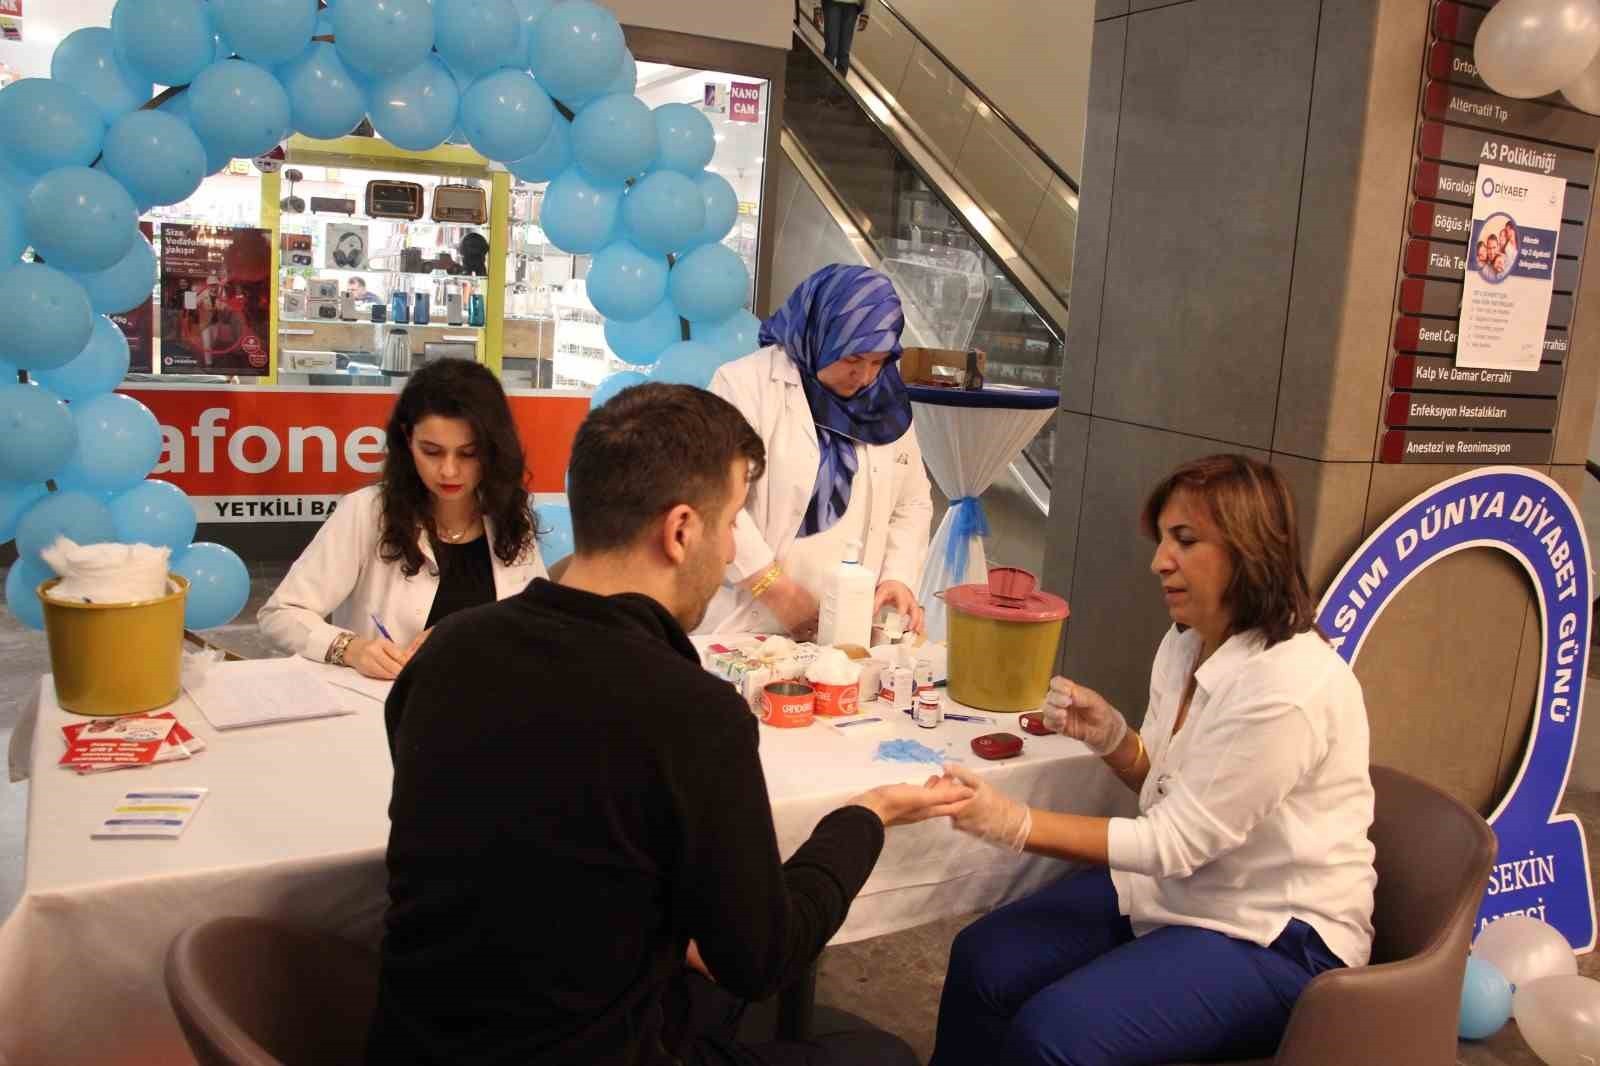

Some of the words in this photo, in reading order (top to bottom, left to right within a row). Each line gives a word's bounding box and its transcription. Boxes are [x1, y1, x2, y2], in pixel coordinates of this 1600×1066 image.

[731, 87, 758, 100] NANO
[733, 103, 755, 114] CAM
[1450, 96, 1493, 115] Alternatif
[1480, 141, 1497, 159] A3
[1500, 145, 1557, 174] Polikliniği
[1439, 176, 1476, 197] Nöroloji
[1434, 214, 1462, 232] Göğüs
[1430, 253, 1452, 268] Fizik
[1418, 327, 1443, 342] Genel
[1416, 366, 1437, 380] Kalp
[1438, 368, 1450, 380] Ve
[1451, 370, 1479, 382] Damar
[1481, 370, 1512, 384] Cerrahi
[1459, 404, 1507, 419] Hastalıkları
[150, 407, 387, 474] afone
[1406, 441, 1444, 454] Anestezi
[1445, 444, 1455, 454] ve
[216, 498, 303, 517] YETKİLİ
[1395, 491, 1505, 560] DÜNYA
[1509, 495, 1577, 601] DİYABET
[1550, 612, 1579, 723] GÜNÜ
[1487, 850, 1555, 895] SEKİN
